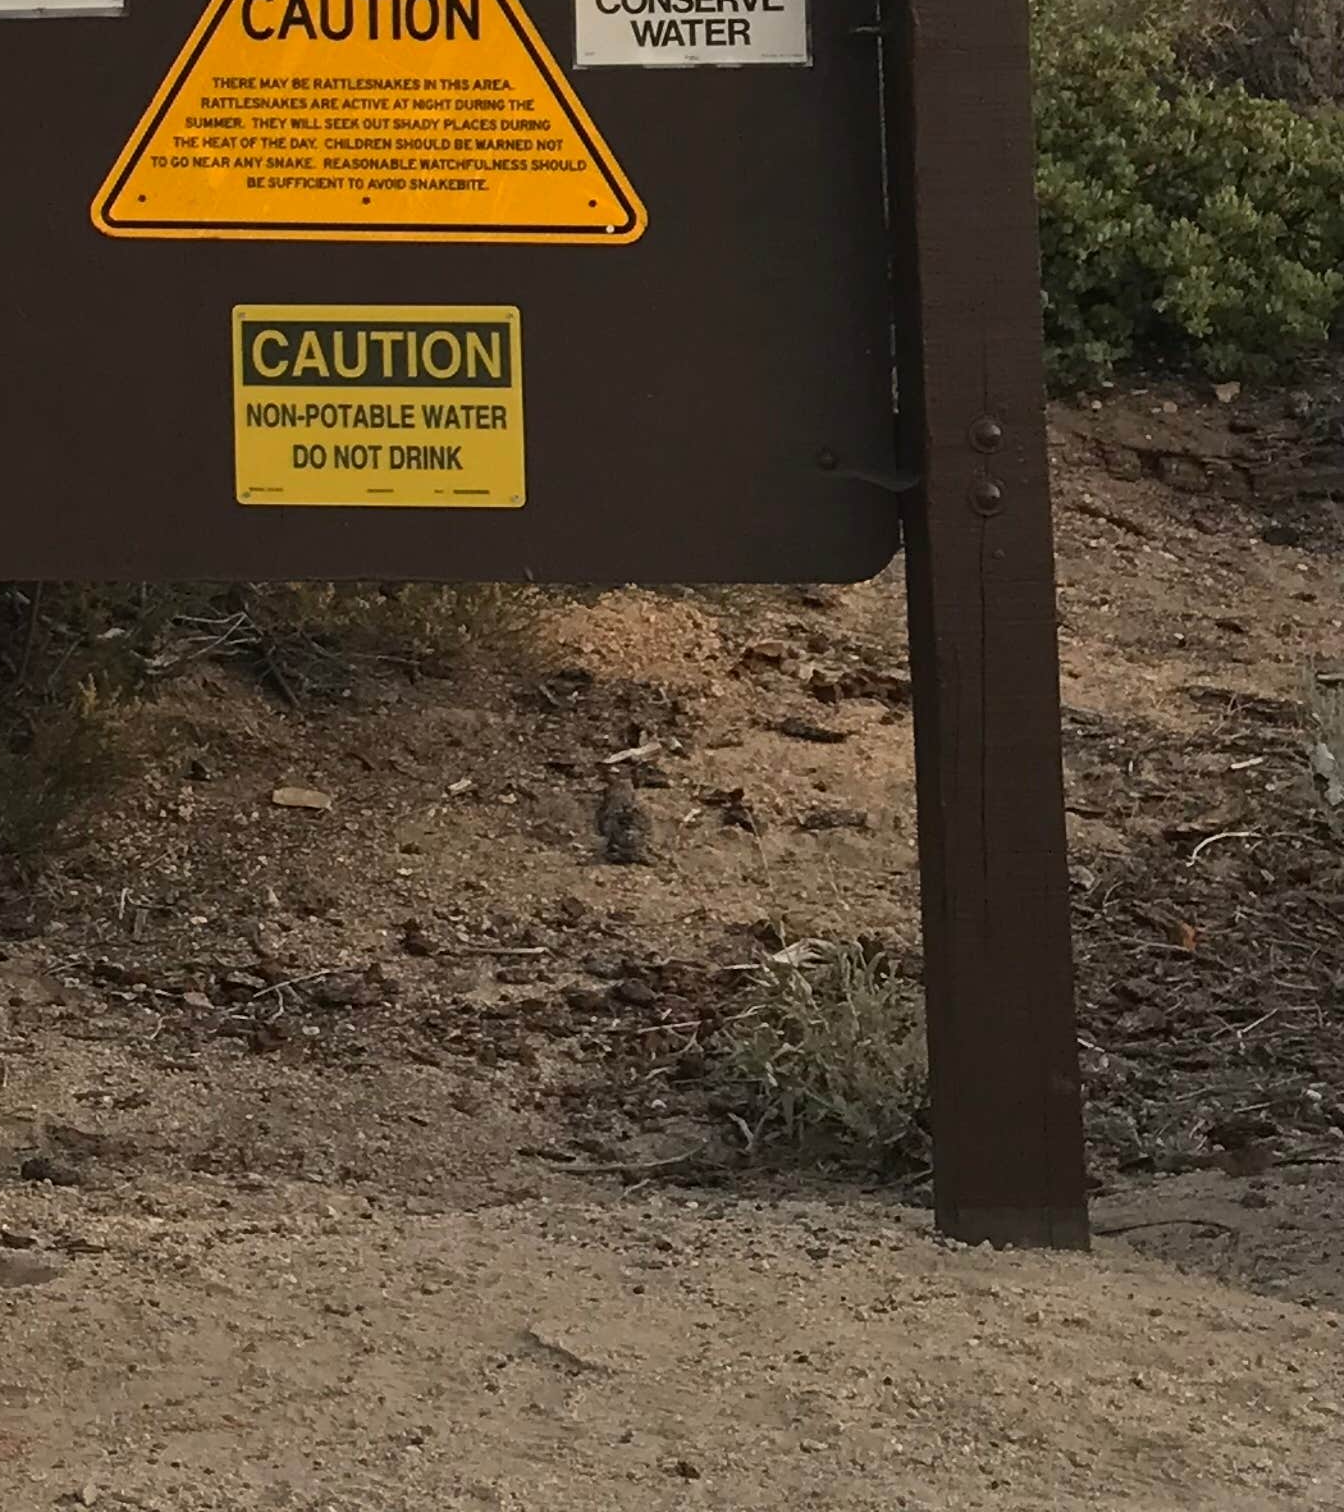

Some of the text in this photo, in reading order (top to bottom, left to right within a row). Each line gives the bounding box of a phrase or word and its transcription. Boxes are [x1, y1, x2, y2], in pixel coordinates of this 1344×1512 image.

[629, 18, 752, 48] WATER
[213, 77, 257, 89] THERE
[259, 78, 289, 89] MAY
[291, 78, 310, 89] BE
[312, 78, 421, 90] RATTLESNAKES
[423, 78, 437, 90] IN
[439, 79, 470, 90] THIS
[200, 97, 535, 111] RATTLESNAKES ARE ACTIVE AT NIGHT DURING THE
[252, 118, 287, 129] THEY
[290, 118, 322, 129] WILL
[324, 118, 360, 129] SEEK
[362, 118, 391, 130] OUT
[392, 119, 440, 131] SHADY
[443, 119, 498, 131] PLACES
[500, 119, 551, 131] DURING
[173, 136, 199, 148] THE
[202, 136, 236, 148] HEAT
[239, 137, 257, 149] OF
[260, 137, 287, 149] THE
[323, 138, 393, 150] CHILDREN
[395, 138, 451, 150] SHOULD
[454, 138, 473, 150] BE
[475, 139, 533, 151] WARNED
[536, 139, 564, 151] NOT
[150, 156, 168, 167] TO
[170, 156, 189, 167] GO
[192, 156, 230, 168] NEAR
[233, 157, 263, 168] ANY
[323, 158, 417, 170] REASONABLE
[419, 159, 528, 171] WATCHFULNESS
[530, 159, 587, 172] SHOULD
[246, 177, 265, 188] BE
[267, 177, 344, 189] SUFFICIENT
[347, 178, 365, 189] TO
[367, 178, 409, 190] AVOID
[251, 329, 503, 380] CAUTION
[246, 402, 508, 431] NON-POTABLE WATER
[292, 443, 464, 471] DO NOT DRINK
